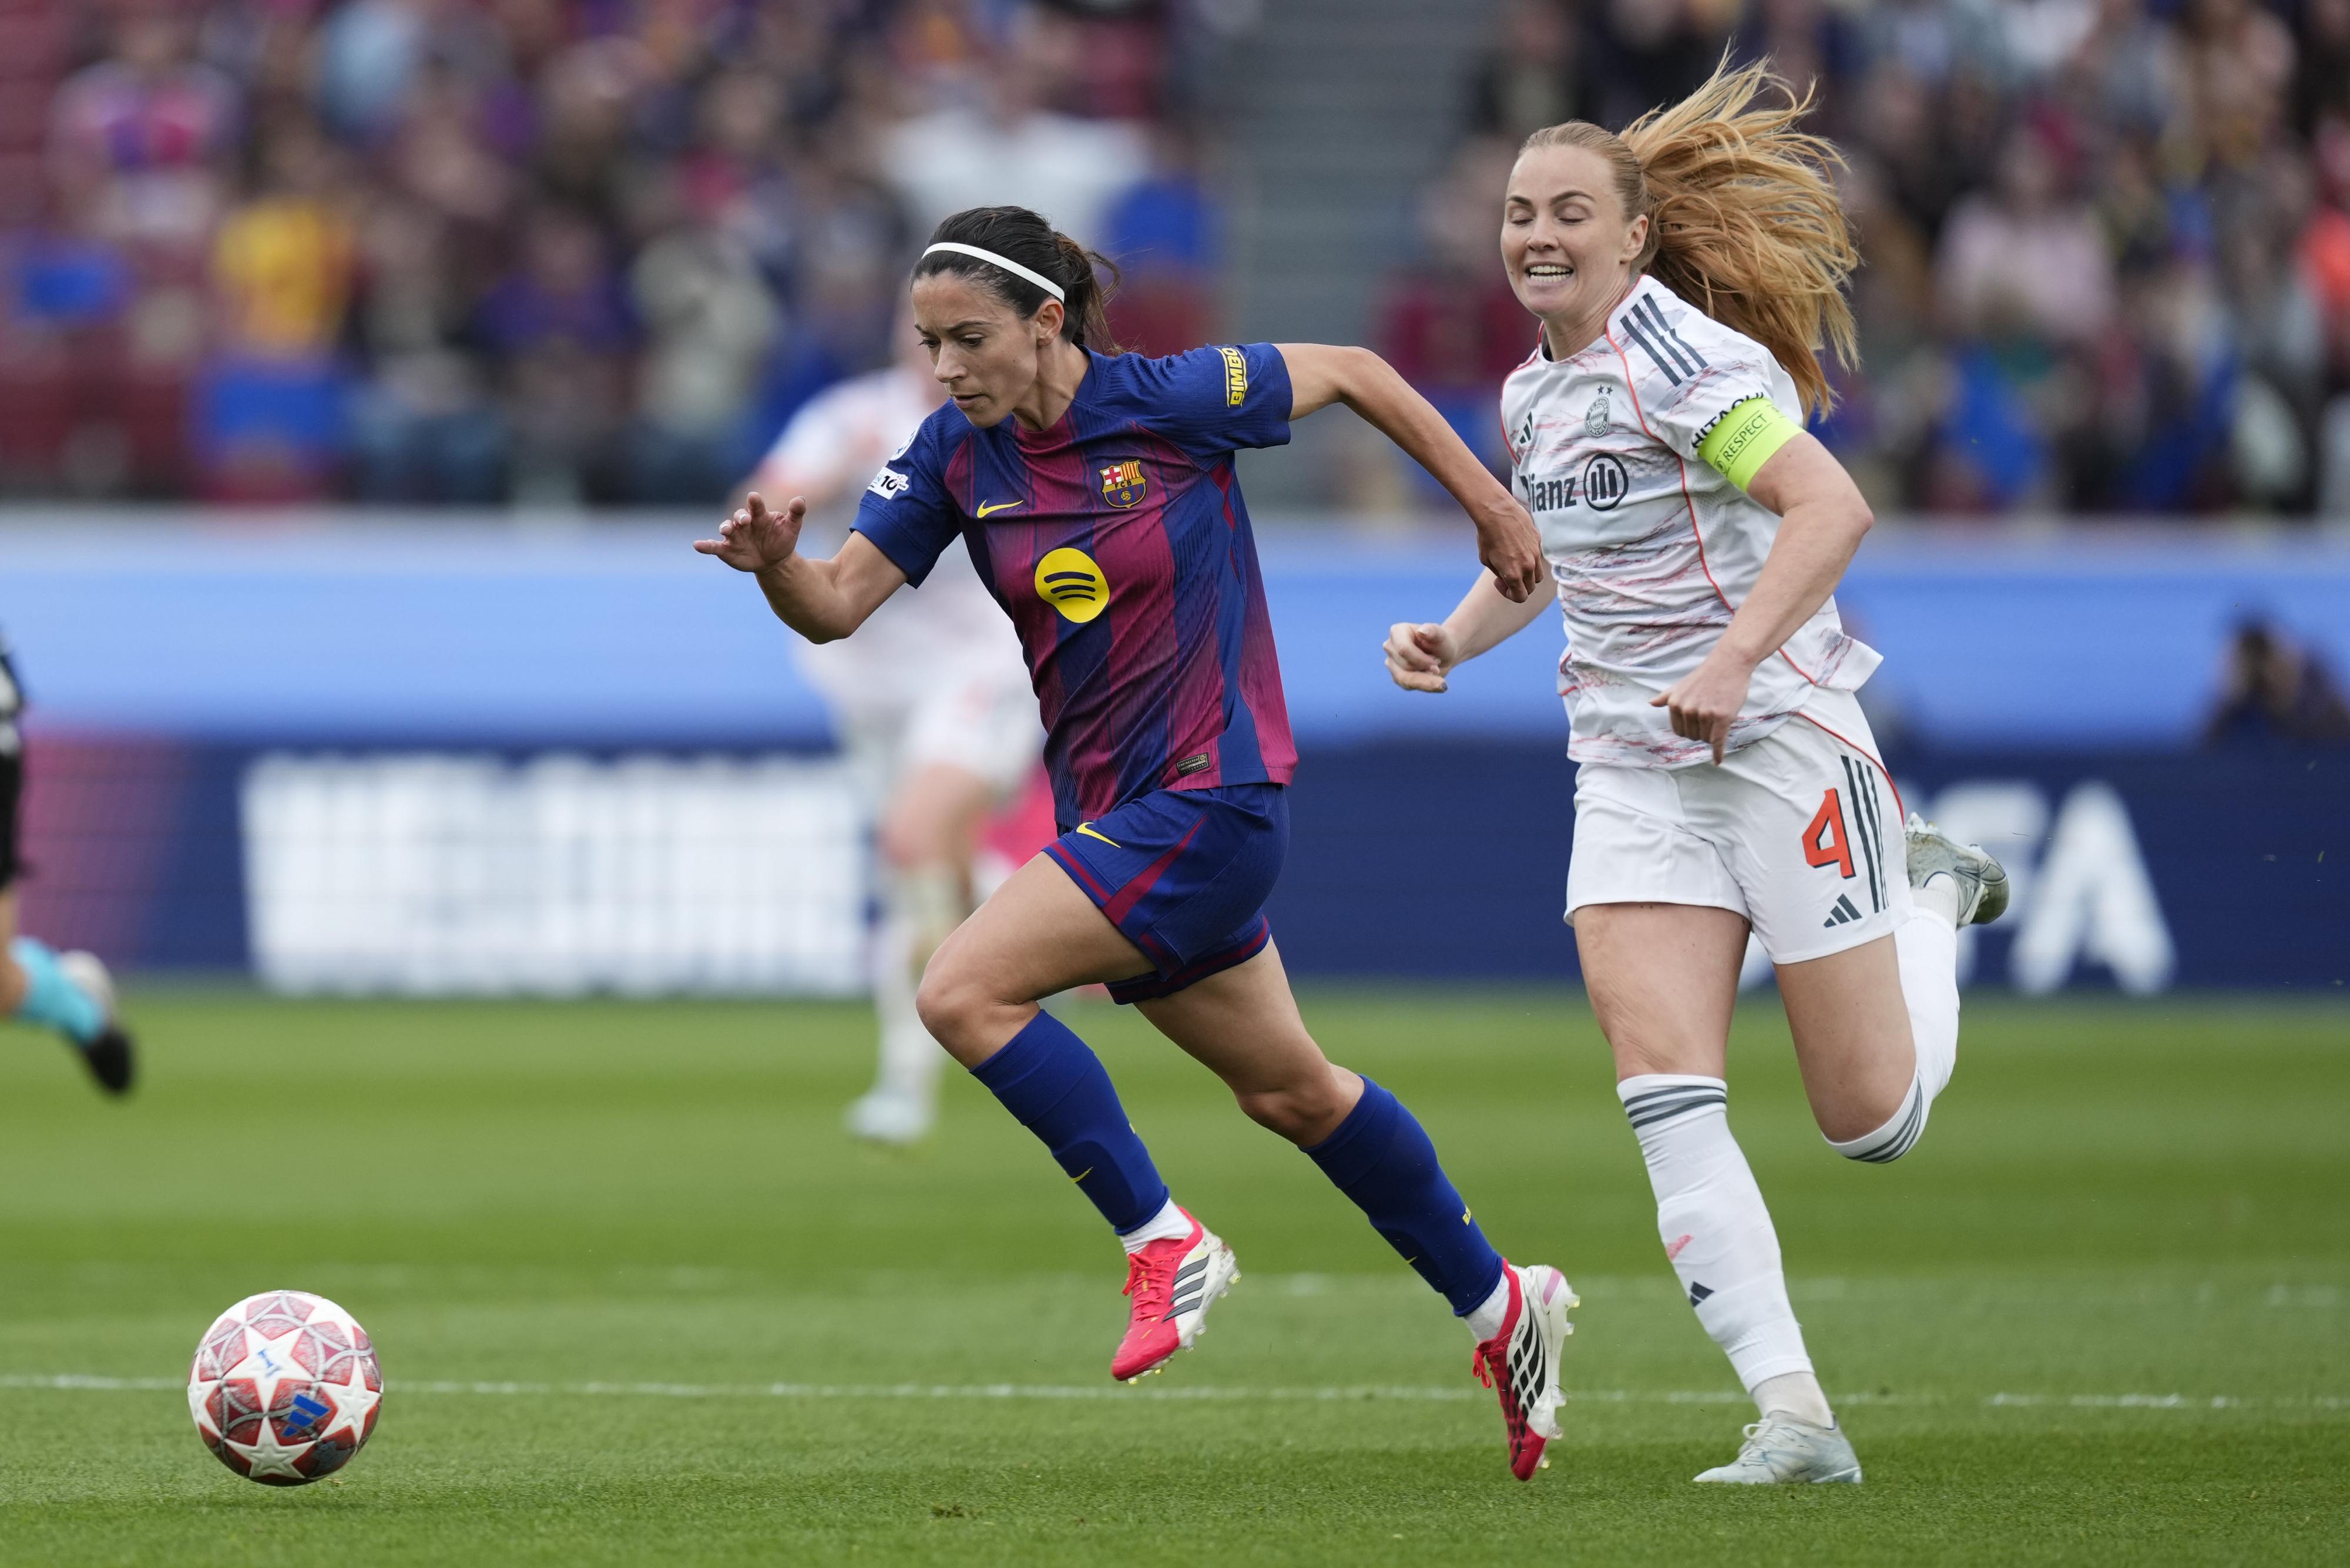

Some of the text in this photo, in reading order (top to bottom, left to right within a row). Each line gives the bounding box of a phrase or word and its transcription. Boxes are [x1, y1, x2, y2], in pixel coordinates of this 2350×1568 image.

[1222, 347, 1245, 405] BIMBO
[1723, 414, 1767, 461] RESPECT
[881, 475, 898, 491] 10
[1114, 480, 1132, 489] FCB
[1802, 787, 1856, 879] 4
